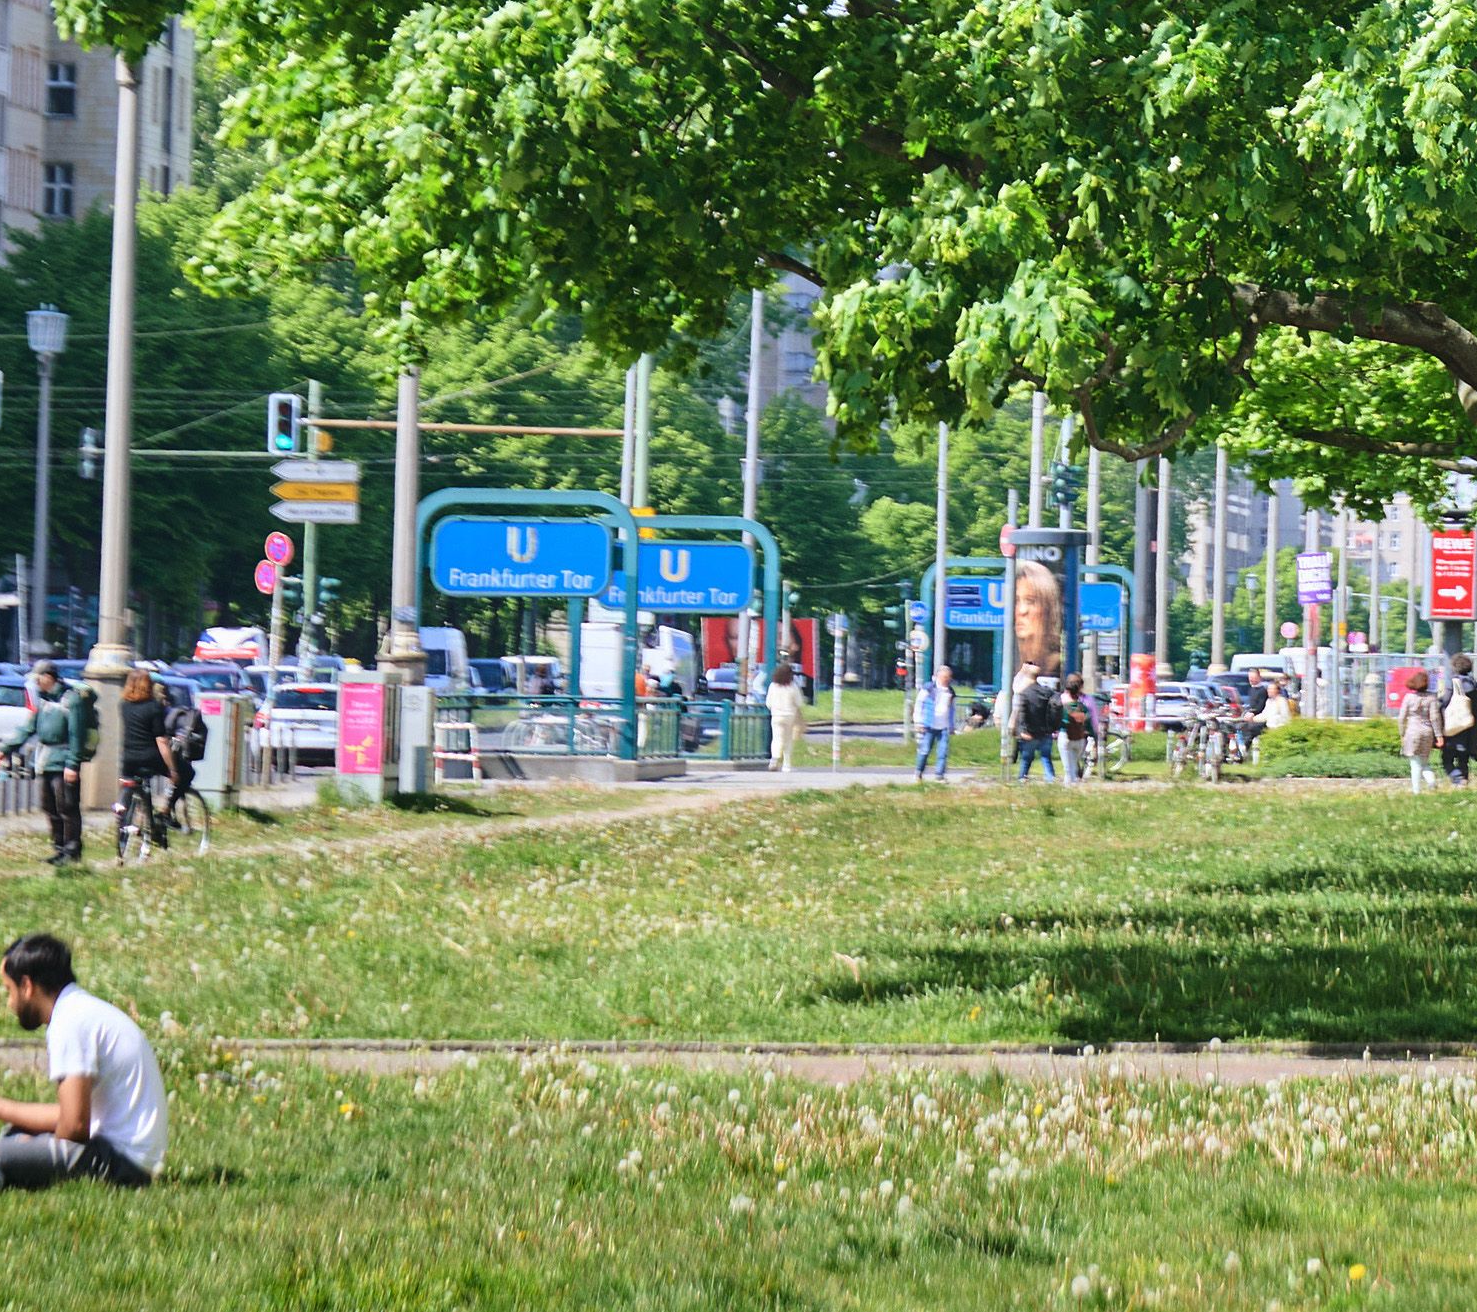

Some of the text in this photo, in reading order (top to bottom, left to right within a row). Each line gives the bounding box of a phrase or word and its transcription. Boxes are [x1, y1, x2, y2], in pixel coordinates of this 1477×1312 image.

[505, 526, 539, 563] U
[448, 567, 596, 590] Frankfurter Tor
[659, 548, 692, 583] U
[608, 585, 741, 606] Frnkfurter Tor
